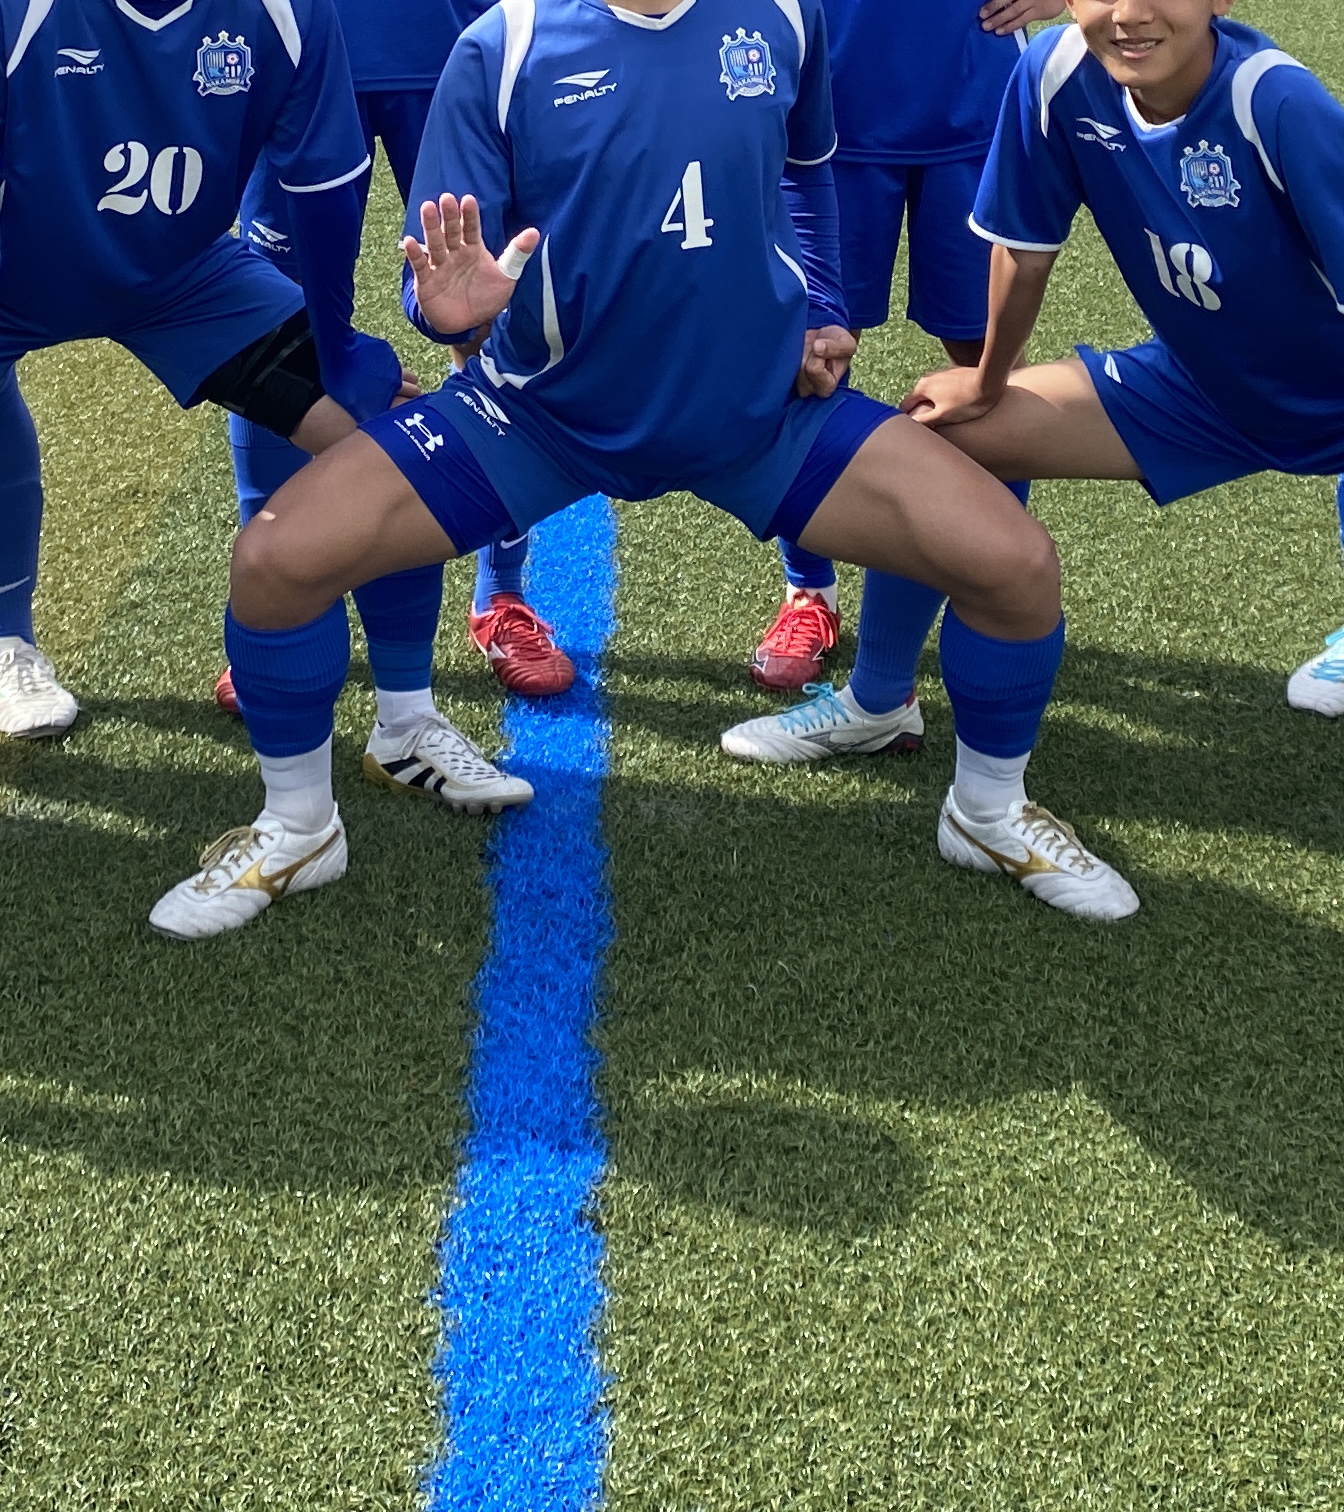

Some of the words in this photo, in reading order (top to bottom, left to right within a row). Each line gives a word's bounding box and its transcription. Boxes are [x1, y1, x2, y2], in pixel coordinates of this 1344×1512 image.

[554, 82, 617, 107] PENALTY
[97, 141, 203, 216] 20
[661, 161, 714, 249] 4
[1144, 227, 1222, 311] 18
[455, 391, 506, 436] PENALTY
